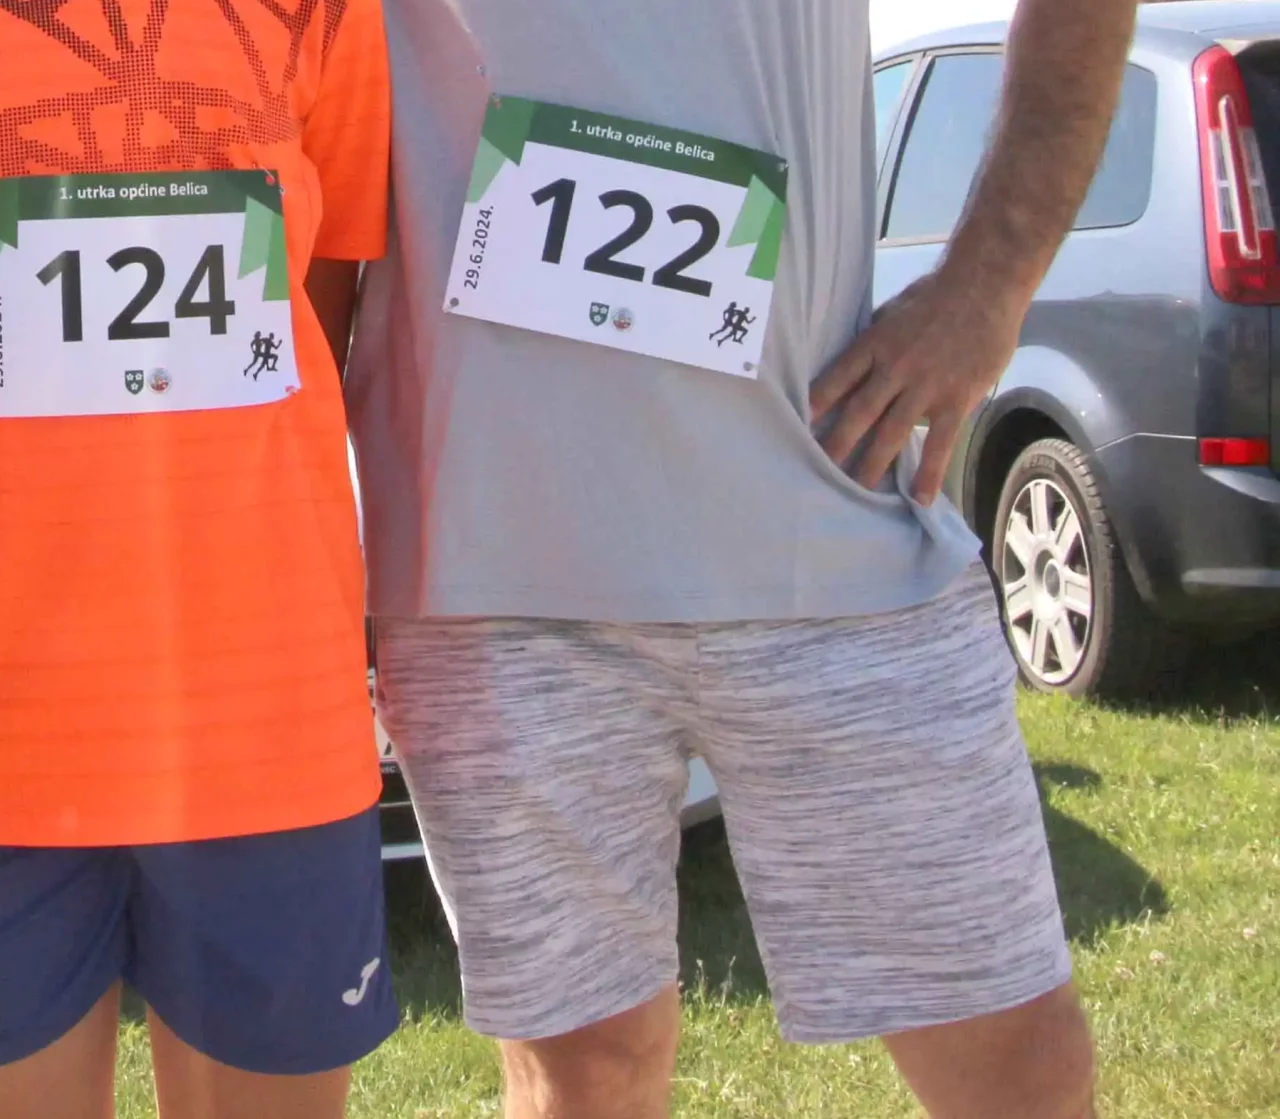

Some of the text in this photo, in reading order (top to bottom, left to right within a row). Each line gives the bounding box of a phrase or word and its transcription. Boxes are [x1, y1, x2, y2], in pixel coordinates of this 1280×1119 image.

[570, 120, 715, 161] 1. utrka općine Belica
[60, 182, 208, 200] 1. utrka općine Belica
[463, 204, 494, 290] 29.6.2024.
[531, 178, 721, 297] 122
[36, 244, 235, 342] 124
